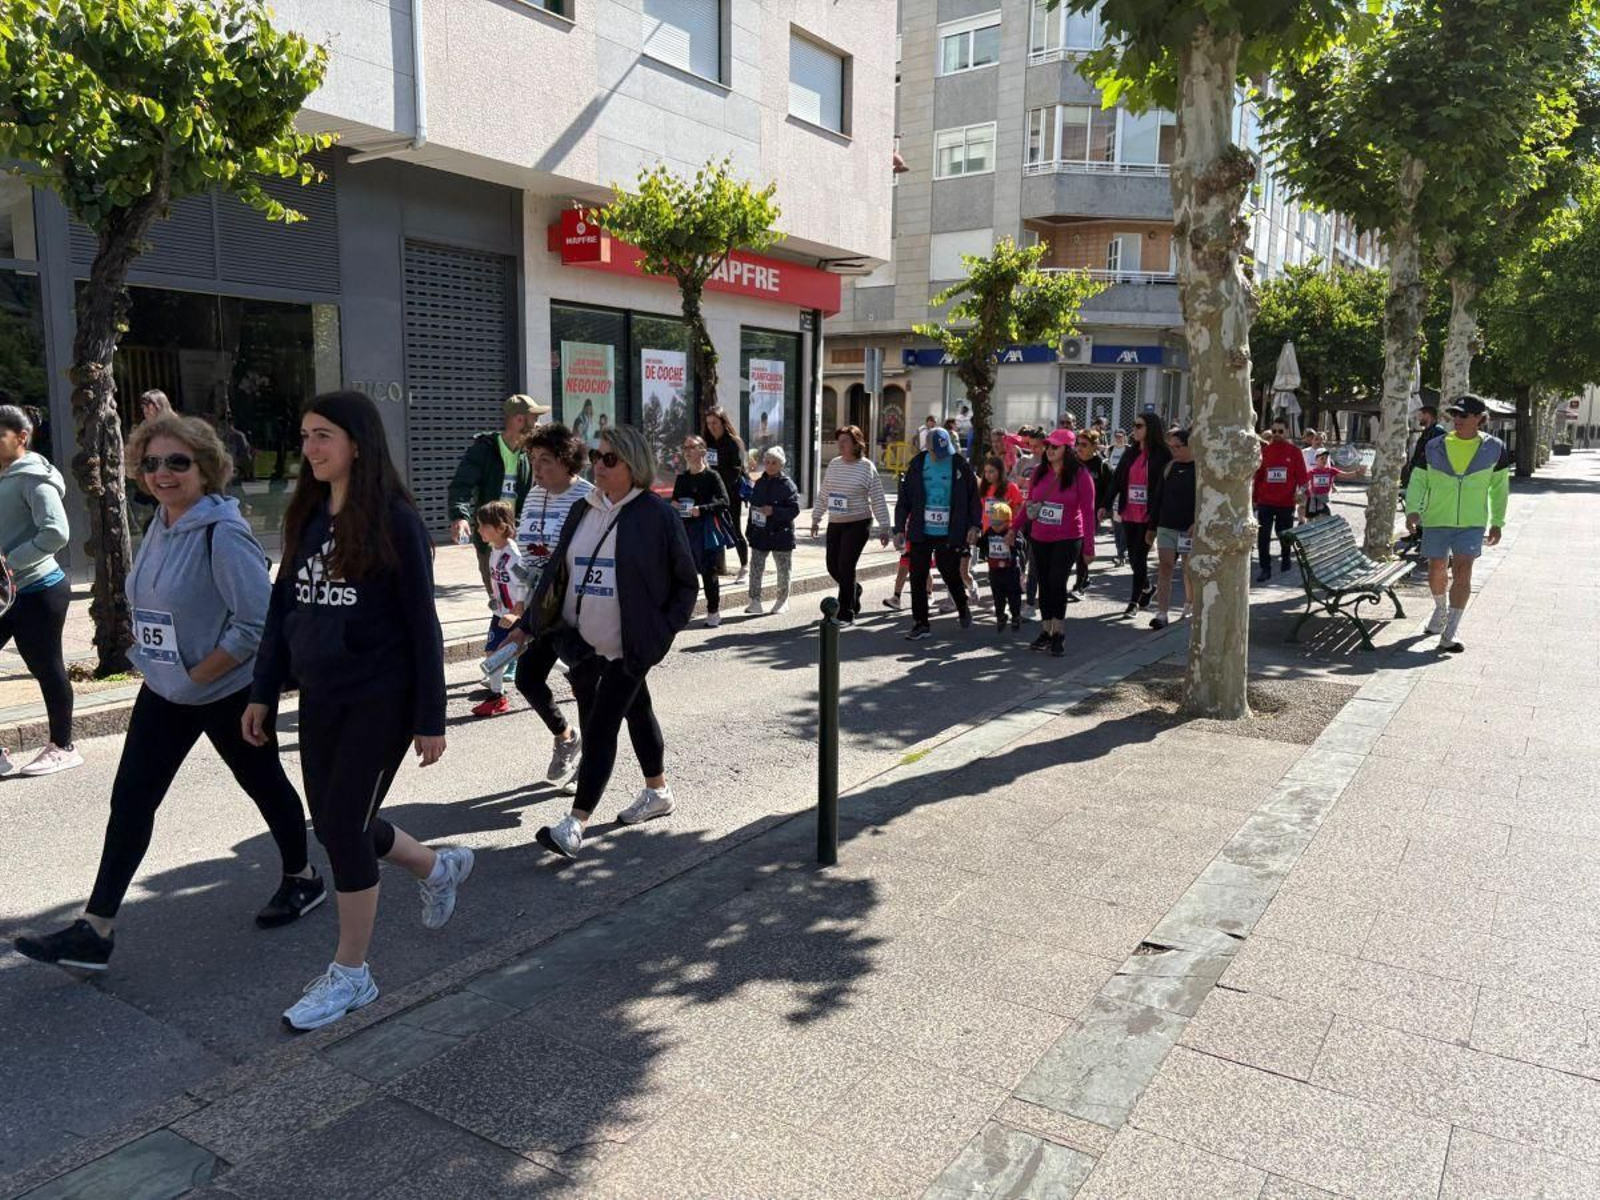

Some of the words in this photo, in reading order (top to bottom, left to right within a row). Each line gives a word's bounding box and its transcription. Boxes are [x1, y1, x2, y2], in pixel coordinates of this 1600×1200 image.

[565, 236, 598, 245] MAPFRE
[1003, 349, 1024, 363] AXA
[1116, 350, 1139, 363] AXA
[645, 364, 656, 380] DE
[657, 365, 684, 381] COCHE
[566, 377, 612, 394] NEGOCIO?
[930, 512, 943, 521] 15
[1041, 507, 1054, 518] 60
[585, 569, 603, 585] 62
[142, 626, 164, 647] 65
